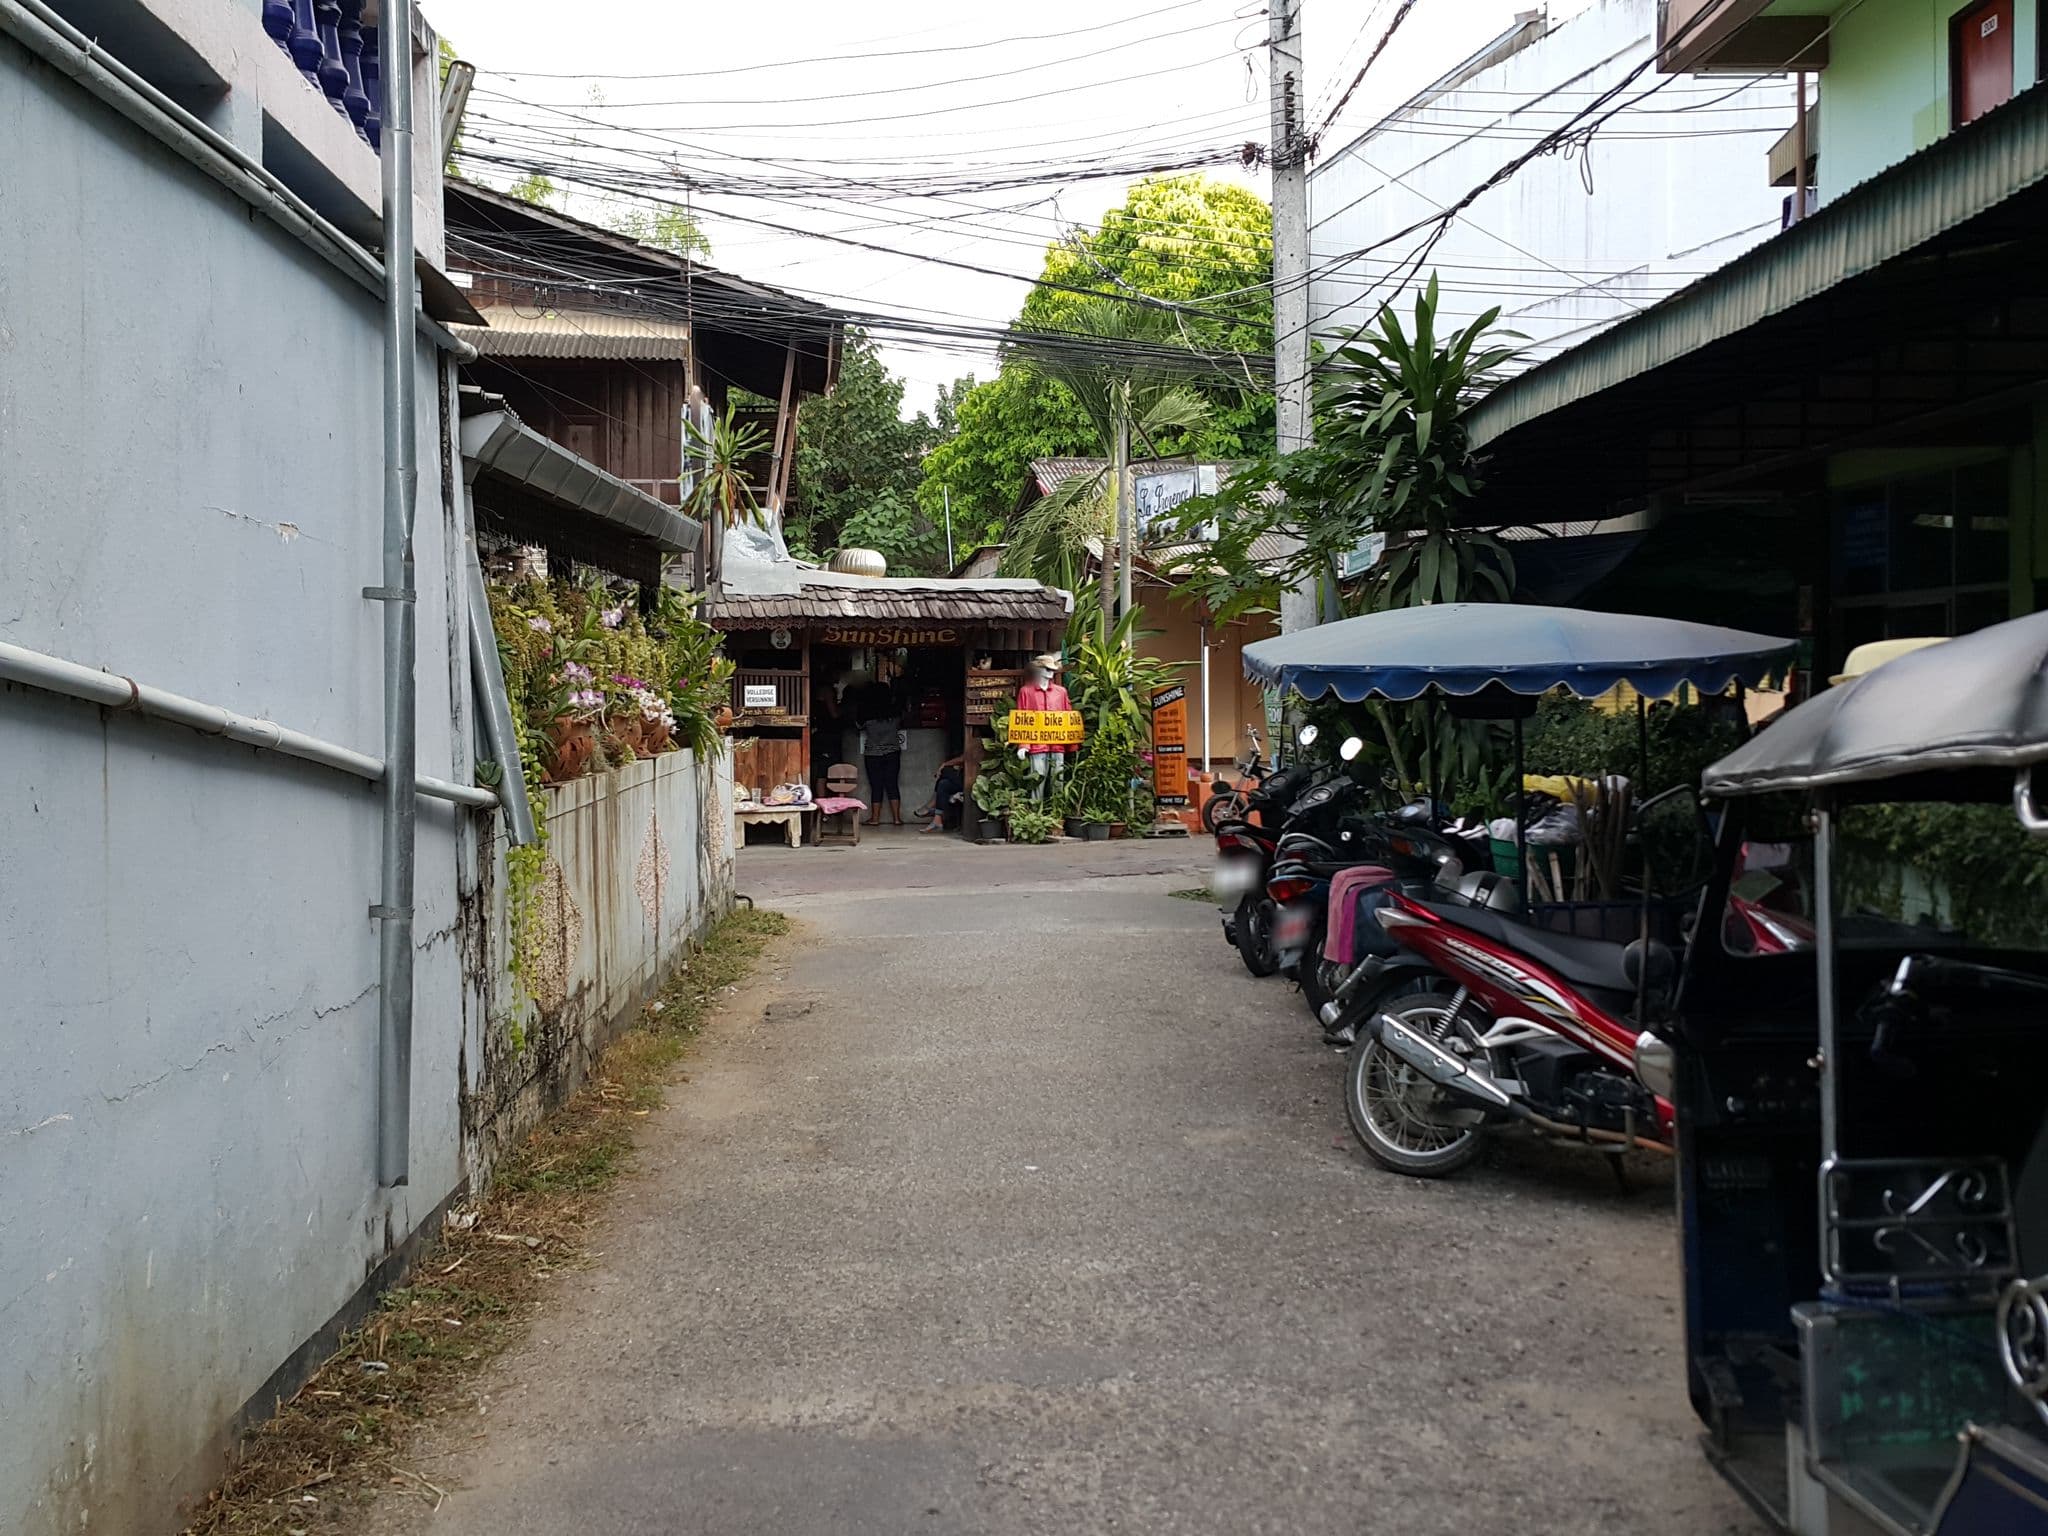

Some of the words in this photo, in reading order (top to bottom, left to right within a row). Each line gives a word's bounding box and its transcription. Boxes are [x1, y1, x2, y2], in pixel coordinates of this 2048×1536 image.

[1153, 686, 1184, 708] SUNSHINE
[1015, 712, 1035, 726] bike
[1044, 713, 1063, 726] bike
[1010, 730, 1038, 740] RENTALS
[1040, 730, 1066, 741] RENTALS
